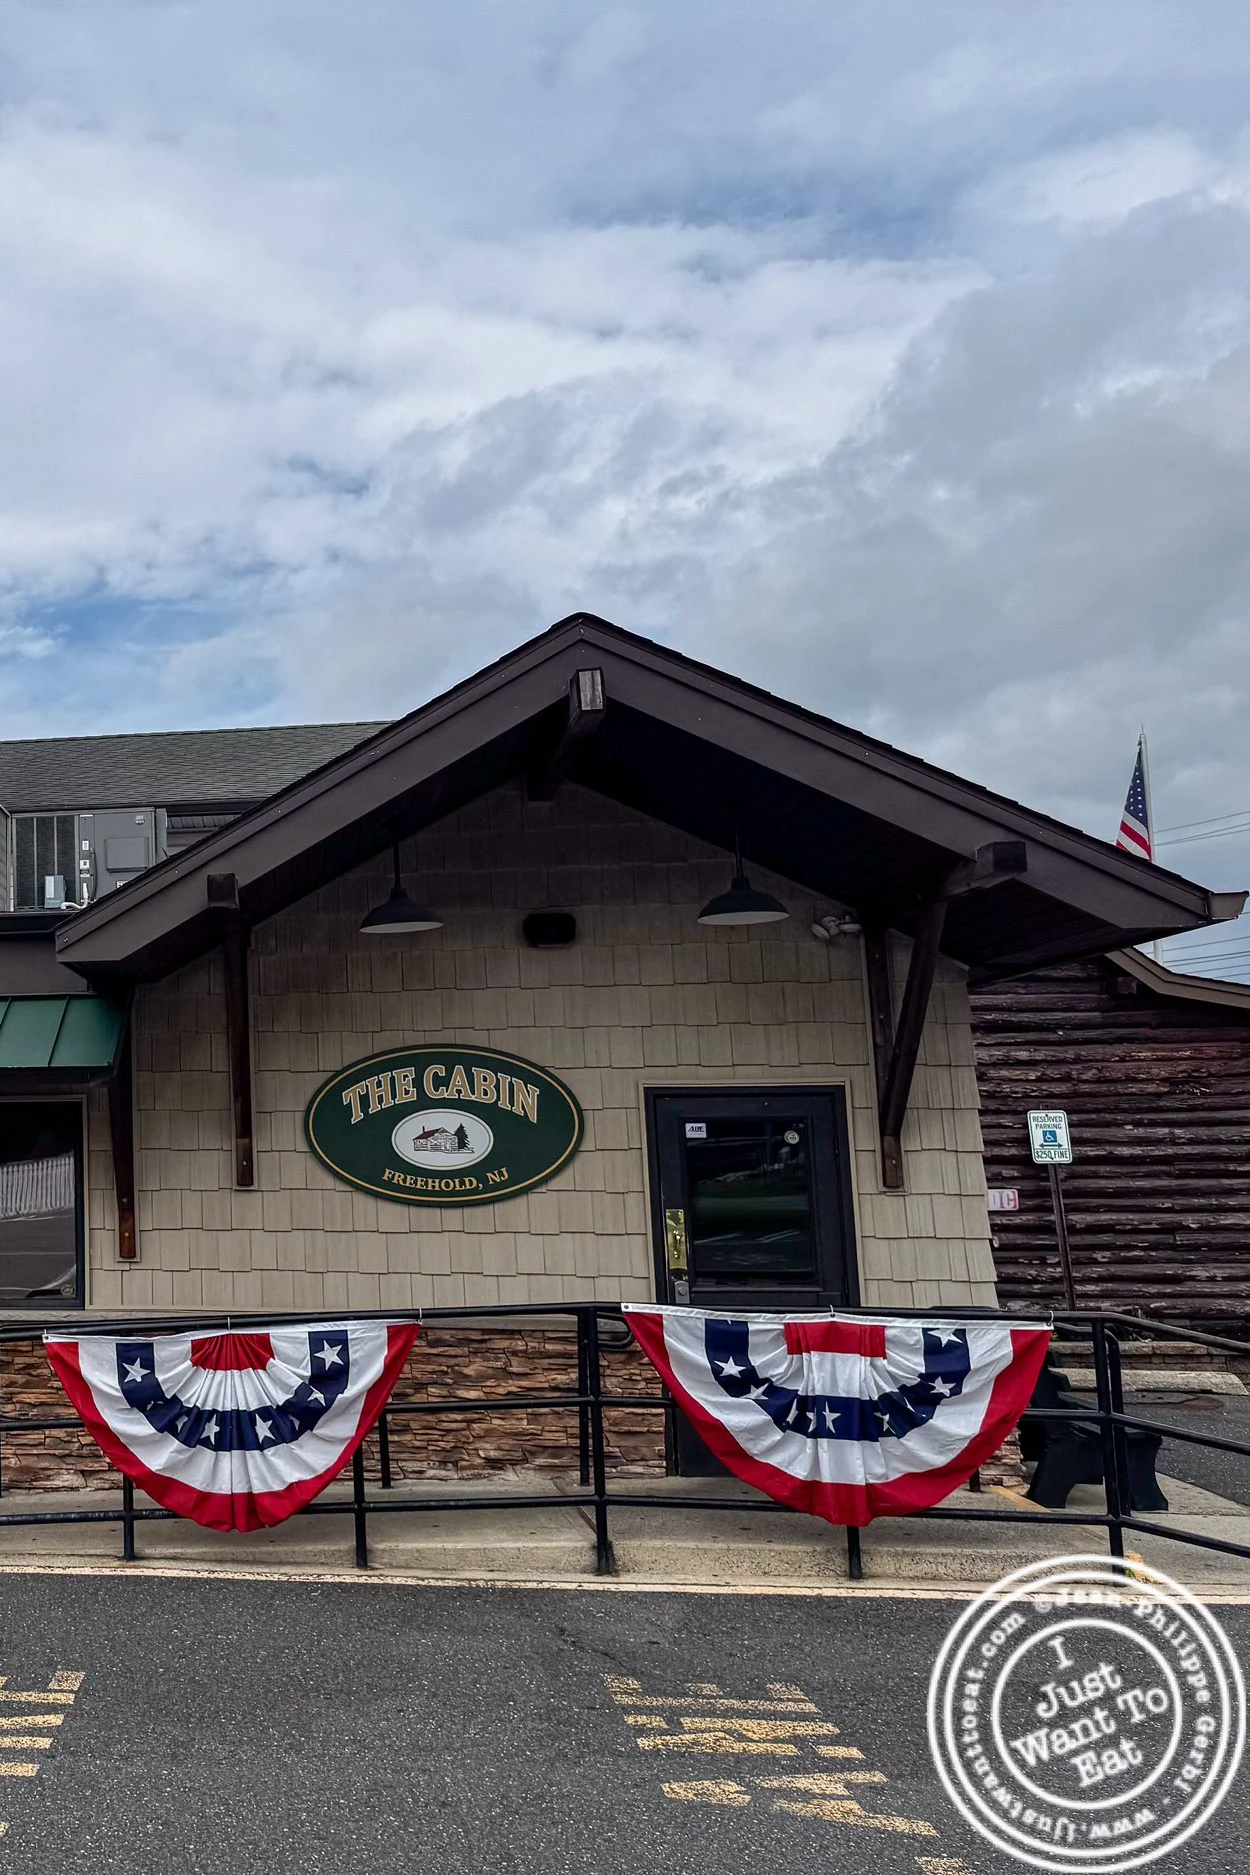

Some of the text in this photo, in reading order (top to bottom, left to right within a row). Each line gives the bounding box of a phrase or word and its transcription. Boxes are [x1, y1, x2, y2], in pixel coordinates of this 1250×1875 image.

[342, 1064, 540, 1125] THE CABIN
[1032, 1115, 1063, 1123] RESERVED
[1035, 1150, 1069, 1159] $250 FINE
[382, 1167, 510, 1192] FREEHOLD, NJ
